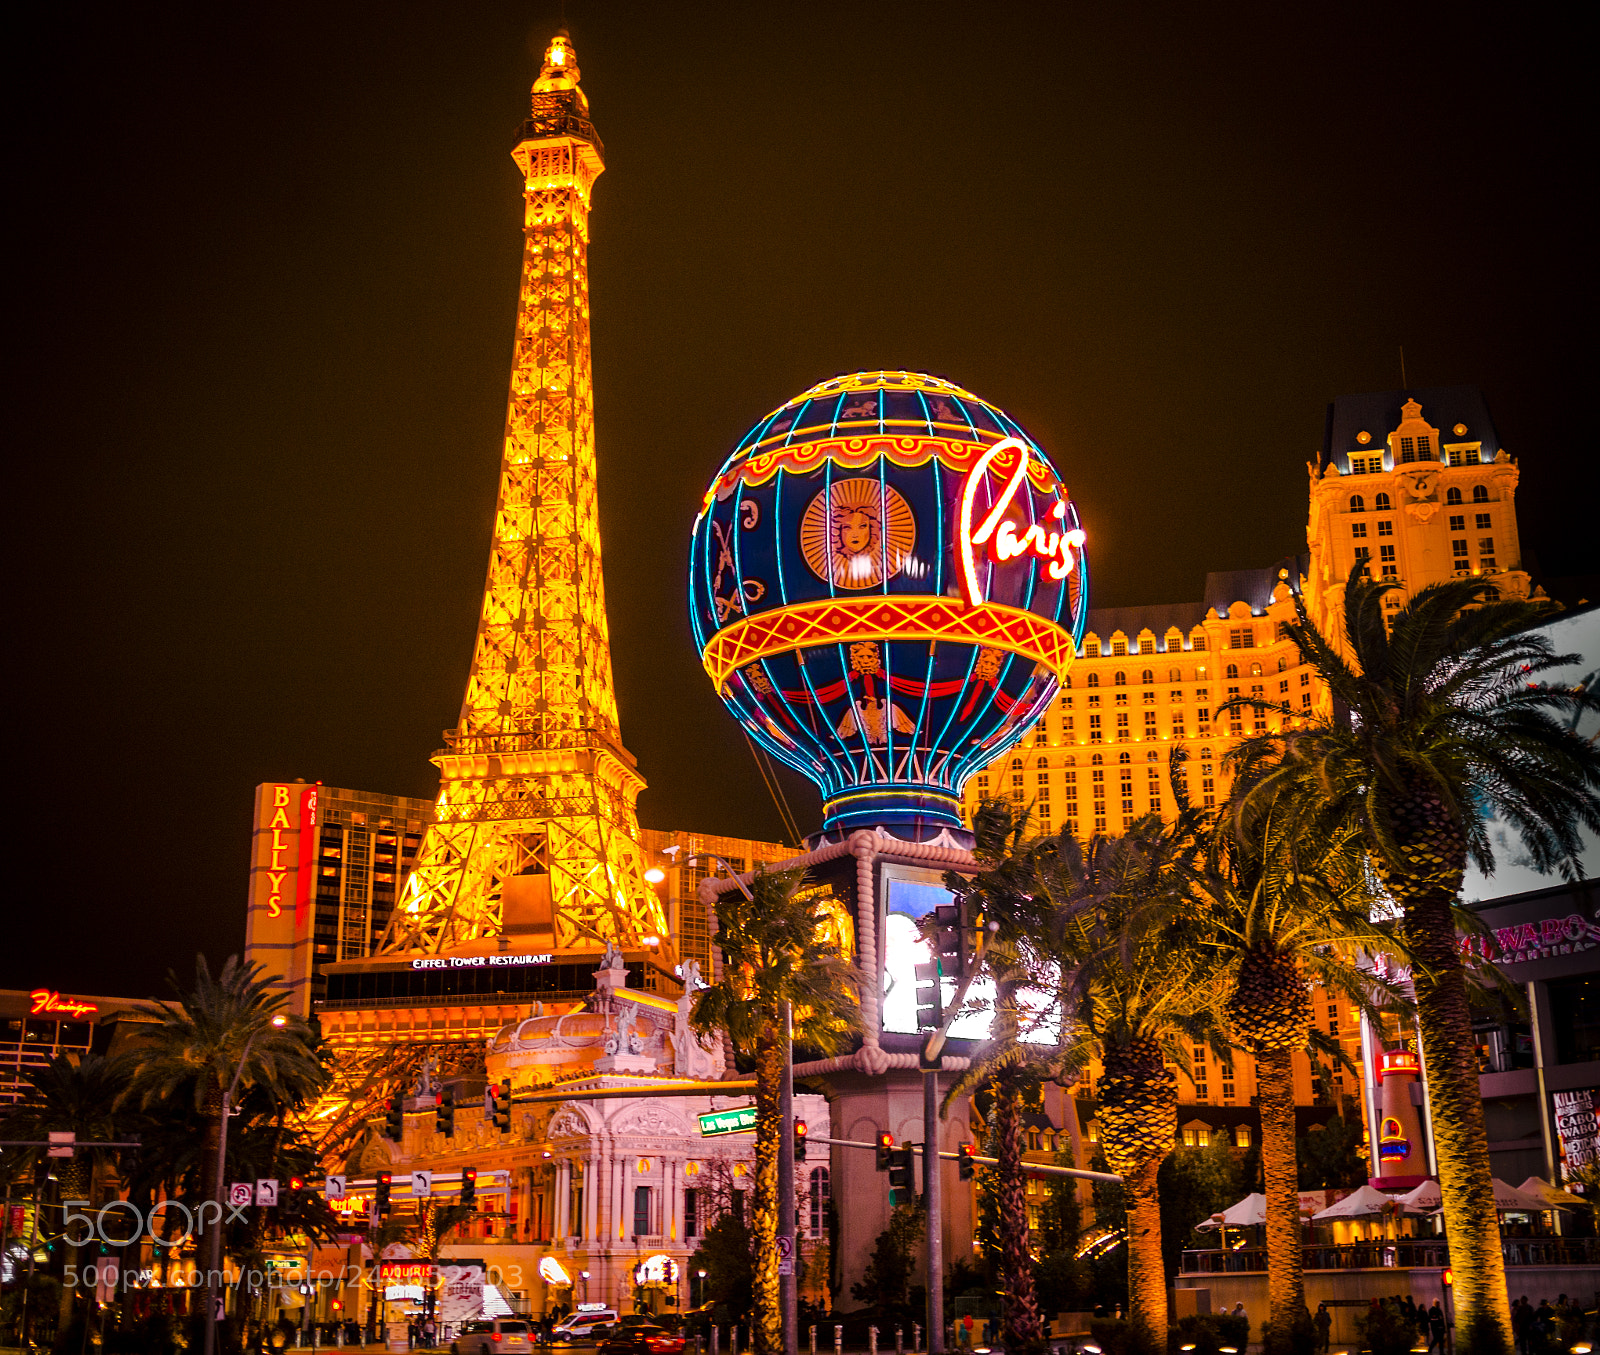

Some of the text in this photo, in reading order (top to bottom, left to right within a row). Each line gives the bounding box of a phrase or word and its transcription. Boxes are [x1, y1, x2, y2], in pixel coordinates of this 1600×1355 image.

[955, 437, 1086, 606] Paris
[266, 785, 291, 918] BALLYS
[1491, 914, 1588, 953] WABO
[413, 953, 553, 969] EIFFEL TOWER RESTAURANT
[1502, 941, 1586, 965] CANTINA
[31, 989, 98, 1019] Flamingo
[1553, 1089, 1592, 1109] KILLER
[700, 1120, 716, 1131] Las
[715, 1117, 739, 1131] Vegas
[1560, 1112, 1595, 1128] CABO
[1562, 1122, 1598, 1137] WABO
[1566, 1149, 1593, 1166] FOOD
